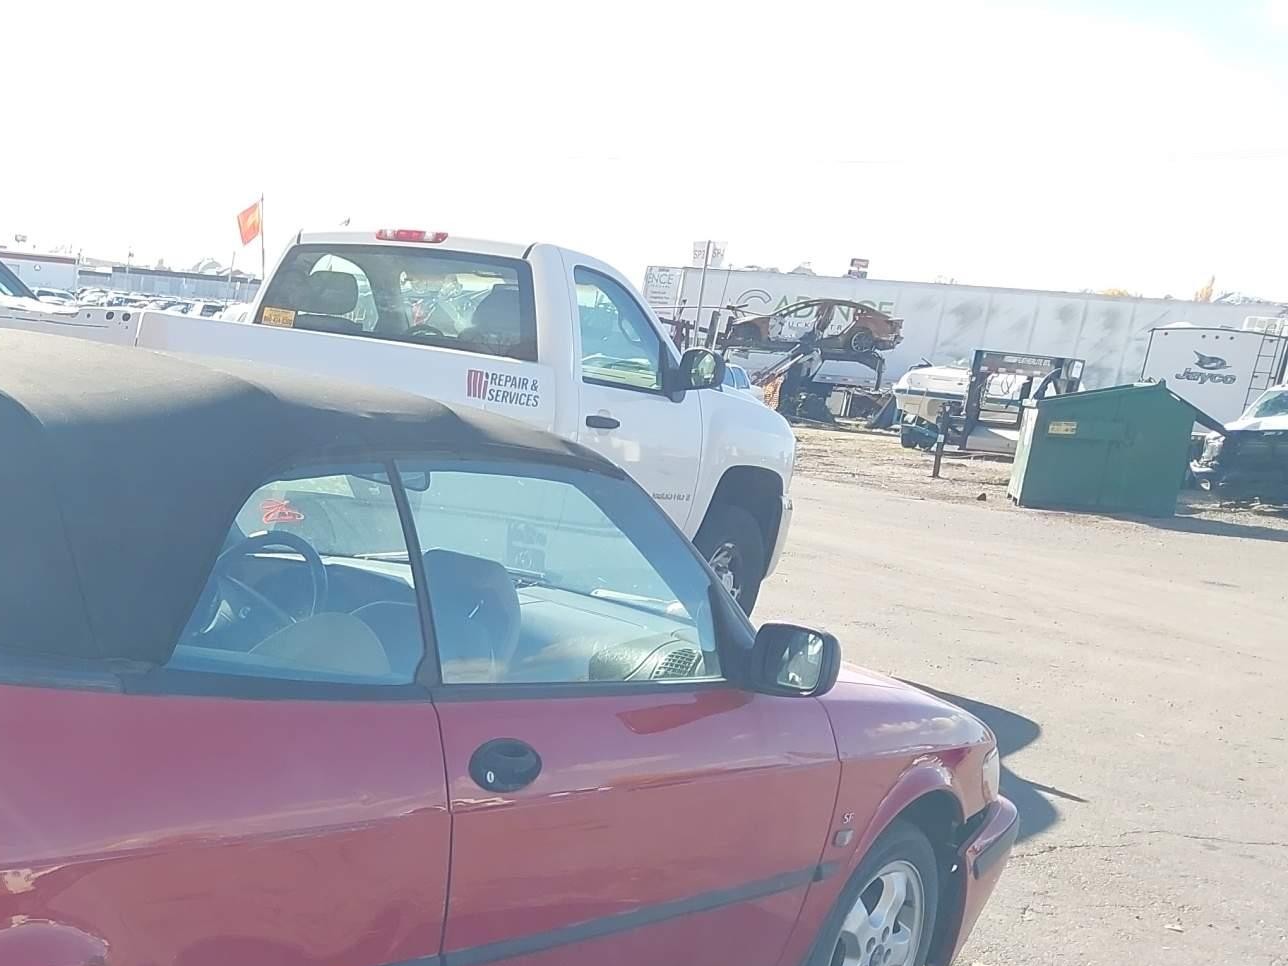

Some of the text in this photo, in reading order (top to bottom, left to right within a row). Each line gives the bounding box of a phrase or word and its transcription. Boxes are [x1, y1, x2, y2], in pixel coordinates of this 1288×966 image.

[490, 372, 539, 391] REPAIR &
[1175, 367, 1237, 385] Jayco
[487, 388, 540, 408] SERVICES
